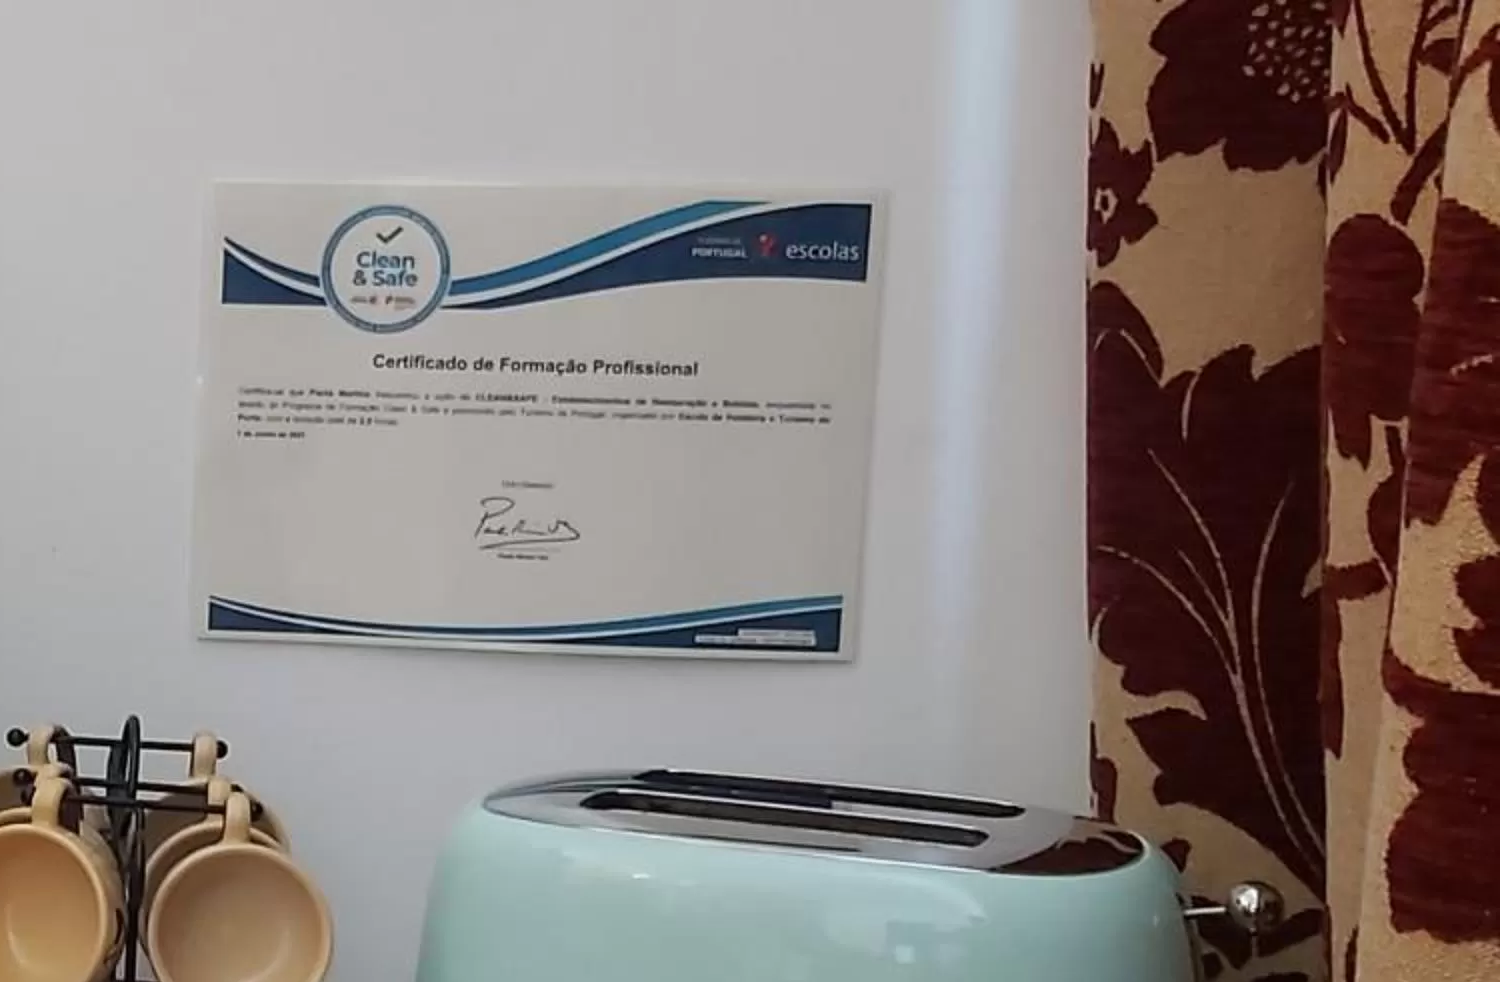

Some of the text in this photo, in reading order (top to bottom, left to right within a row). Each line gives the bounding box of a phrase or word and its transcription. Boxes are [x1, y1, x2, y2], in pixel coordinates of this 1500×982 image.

[356, 250, 415, 269] Clean
[786, 241, 860, 261] escolas
[353, 269, 419, 287] & Safe
[373, 353, 699, 376] Certificado de Formação Profissional
